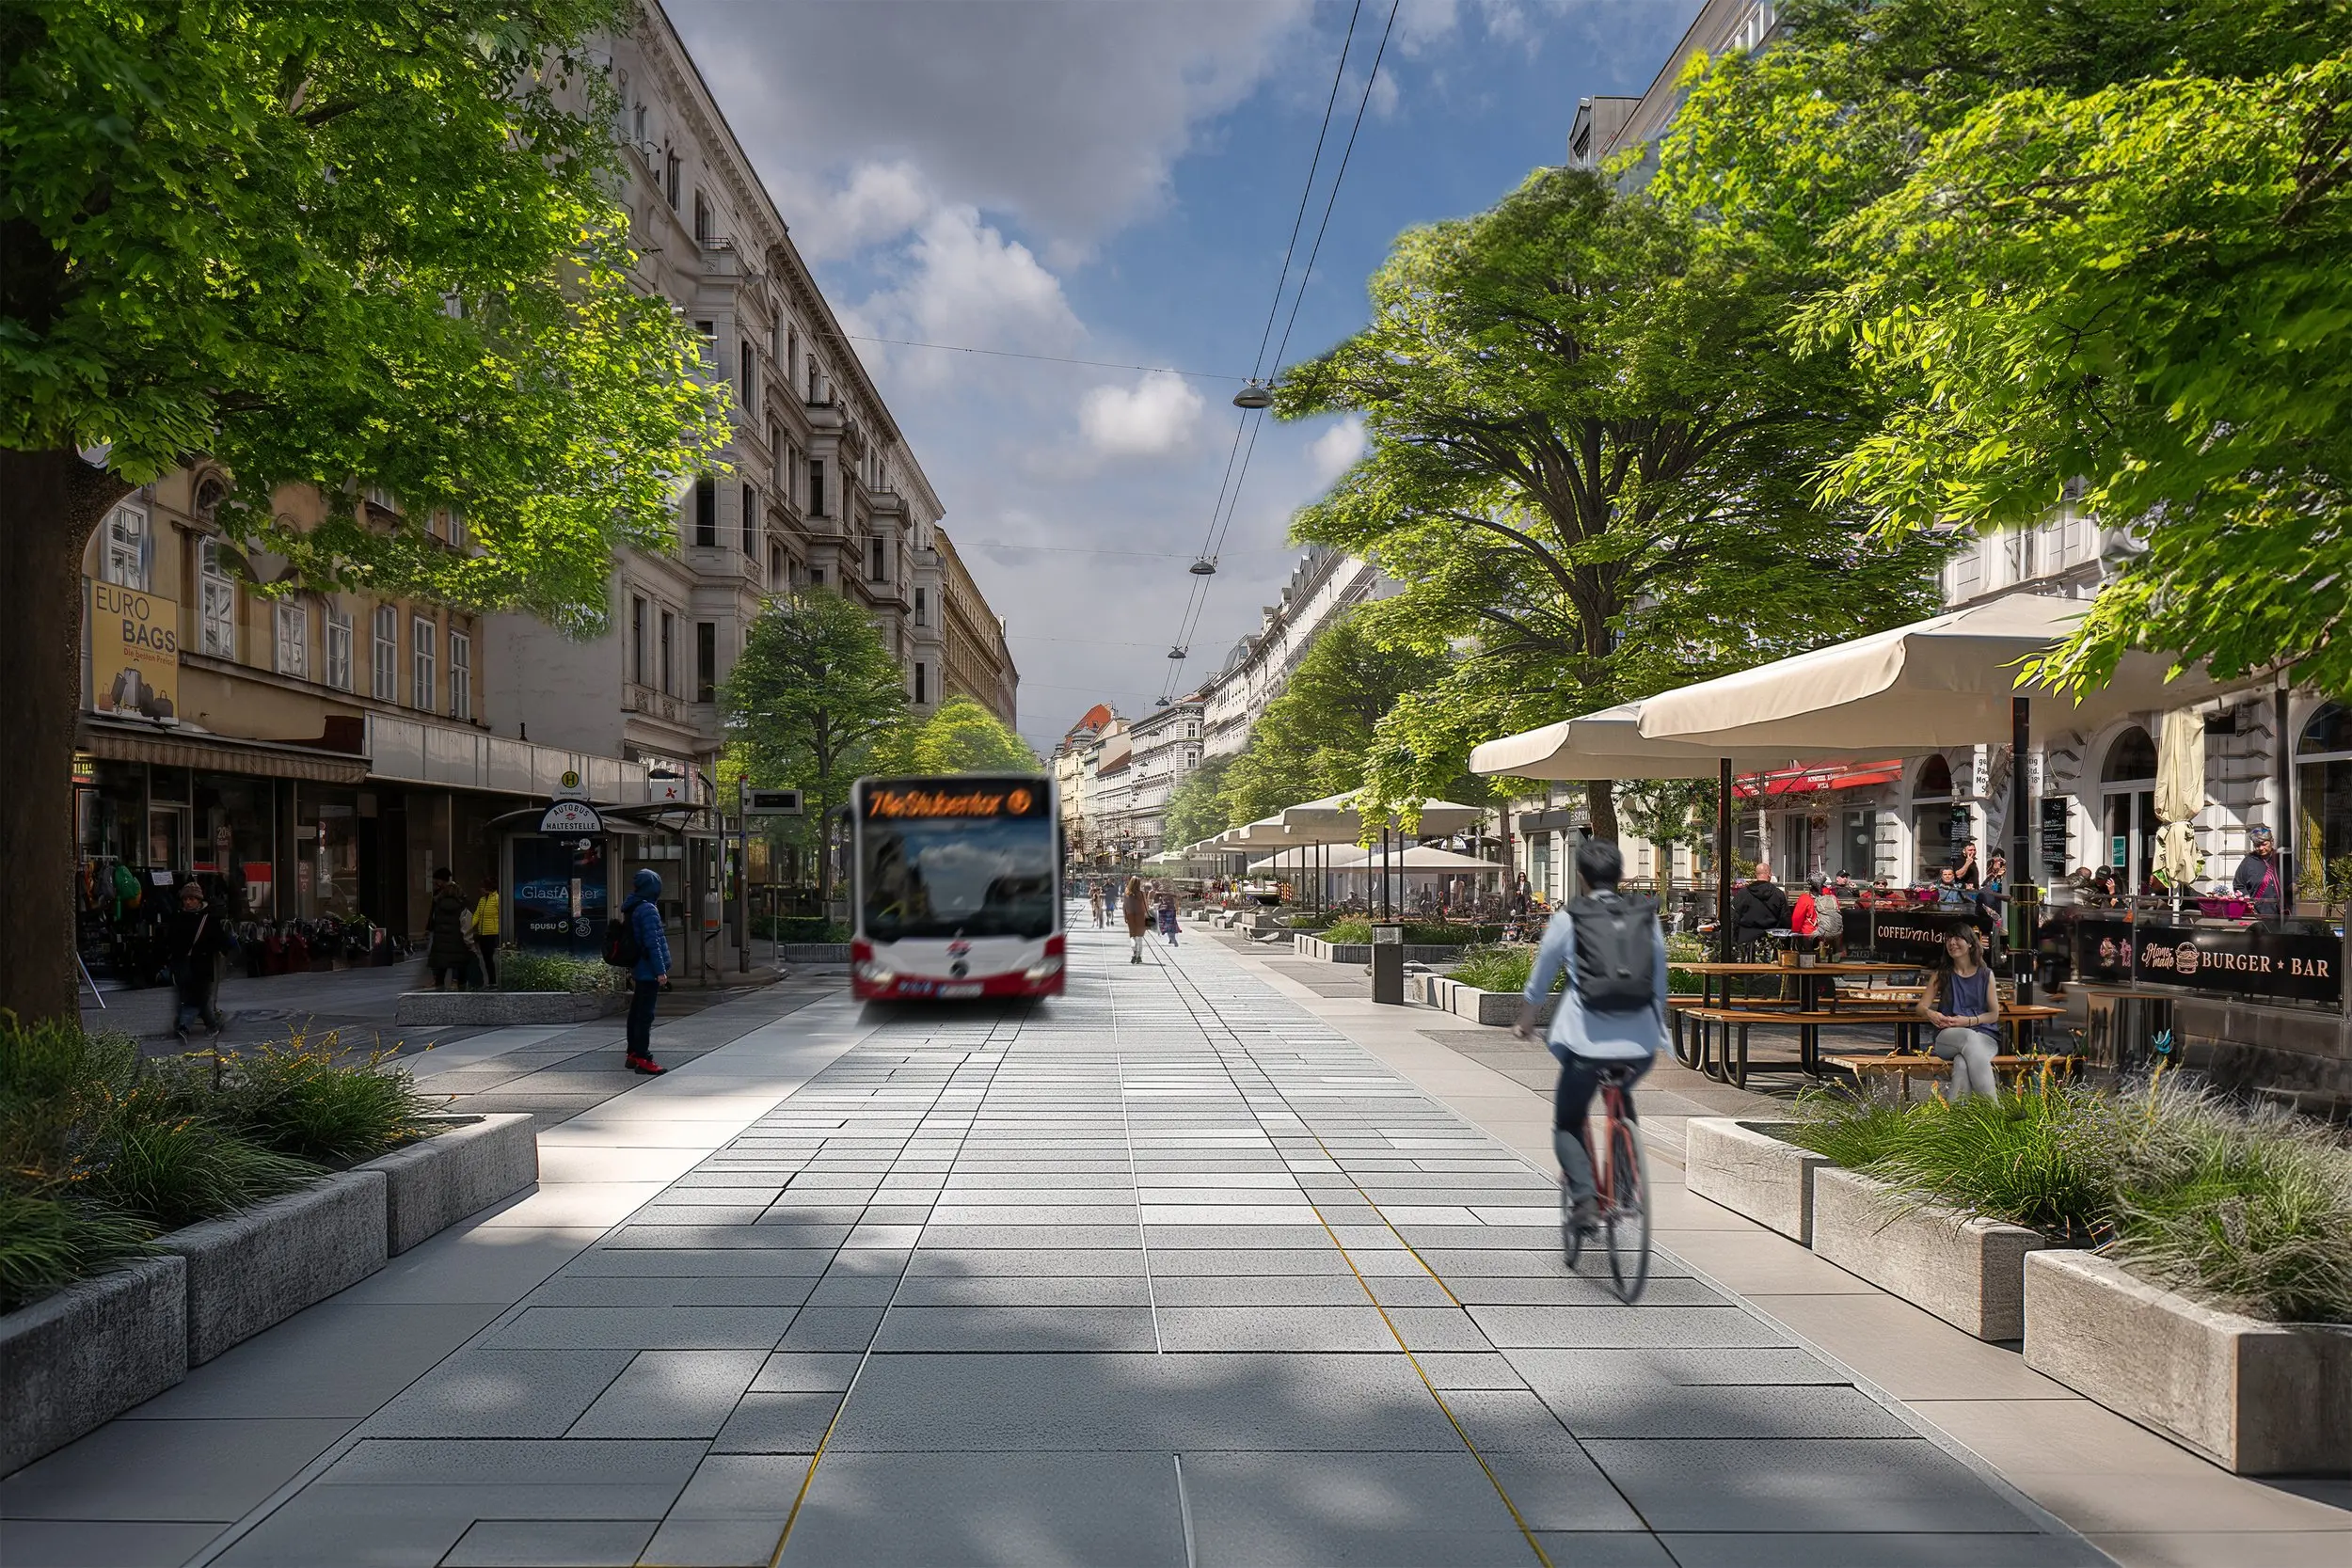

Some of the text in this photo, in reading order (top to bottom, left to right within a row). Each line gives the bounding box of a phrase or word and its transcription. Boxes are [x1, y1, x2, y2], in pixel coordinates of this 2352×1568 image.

[96, 585, 150, 621] EURO
[122, 618, 176, 653] BAGS
[123, 647, 135, 657] Die
[566, 774, 575, 785] H
[553, 804, 590, 816] AUTOBUS
[530, 922, 557, 932] spusu
[2201, 951, 2330, 978] BURGER BAR
